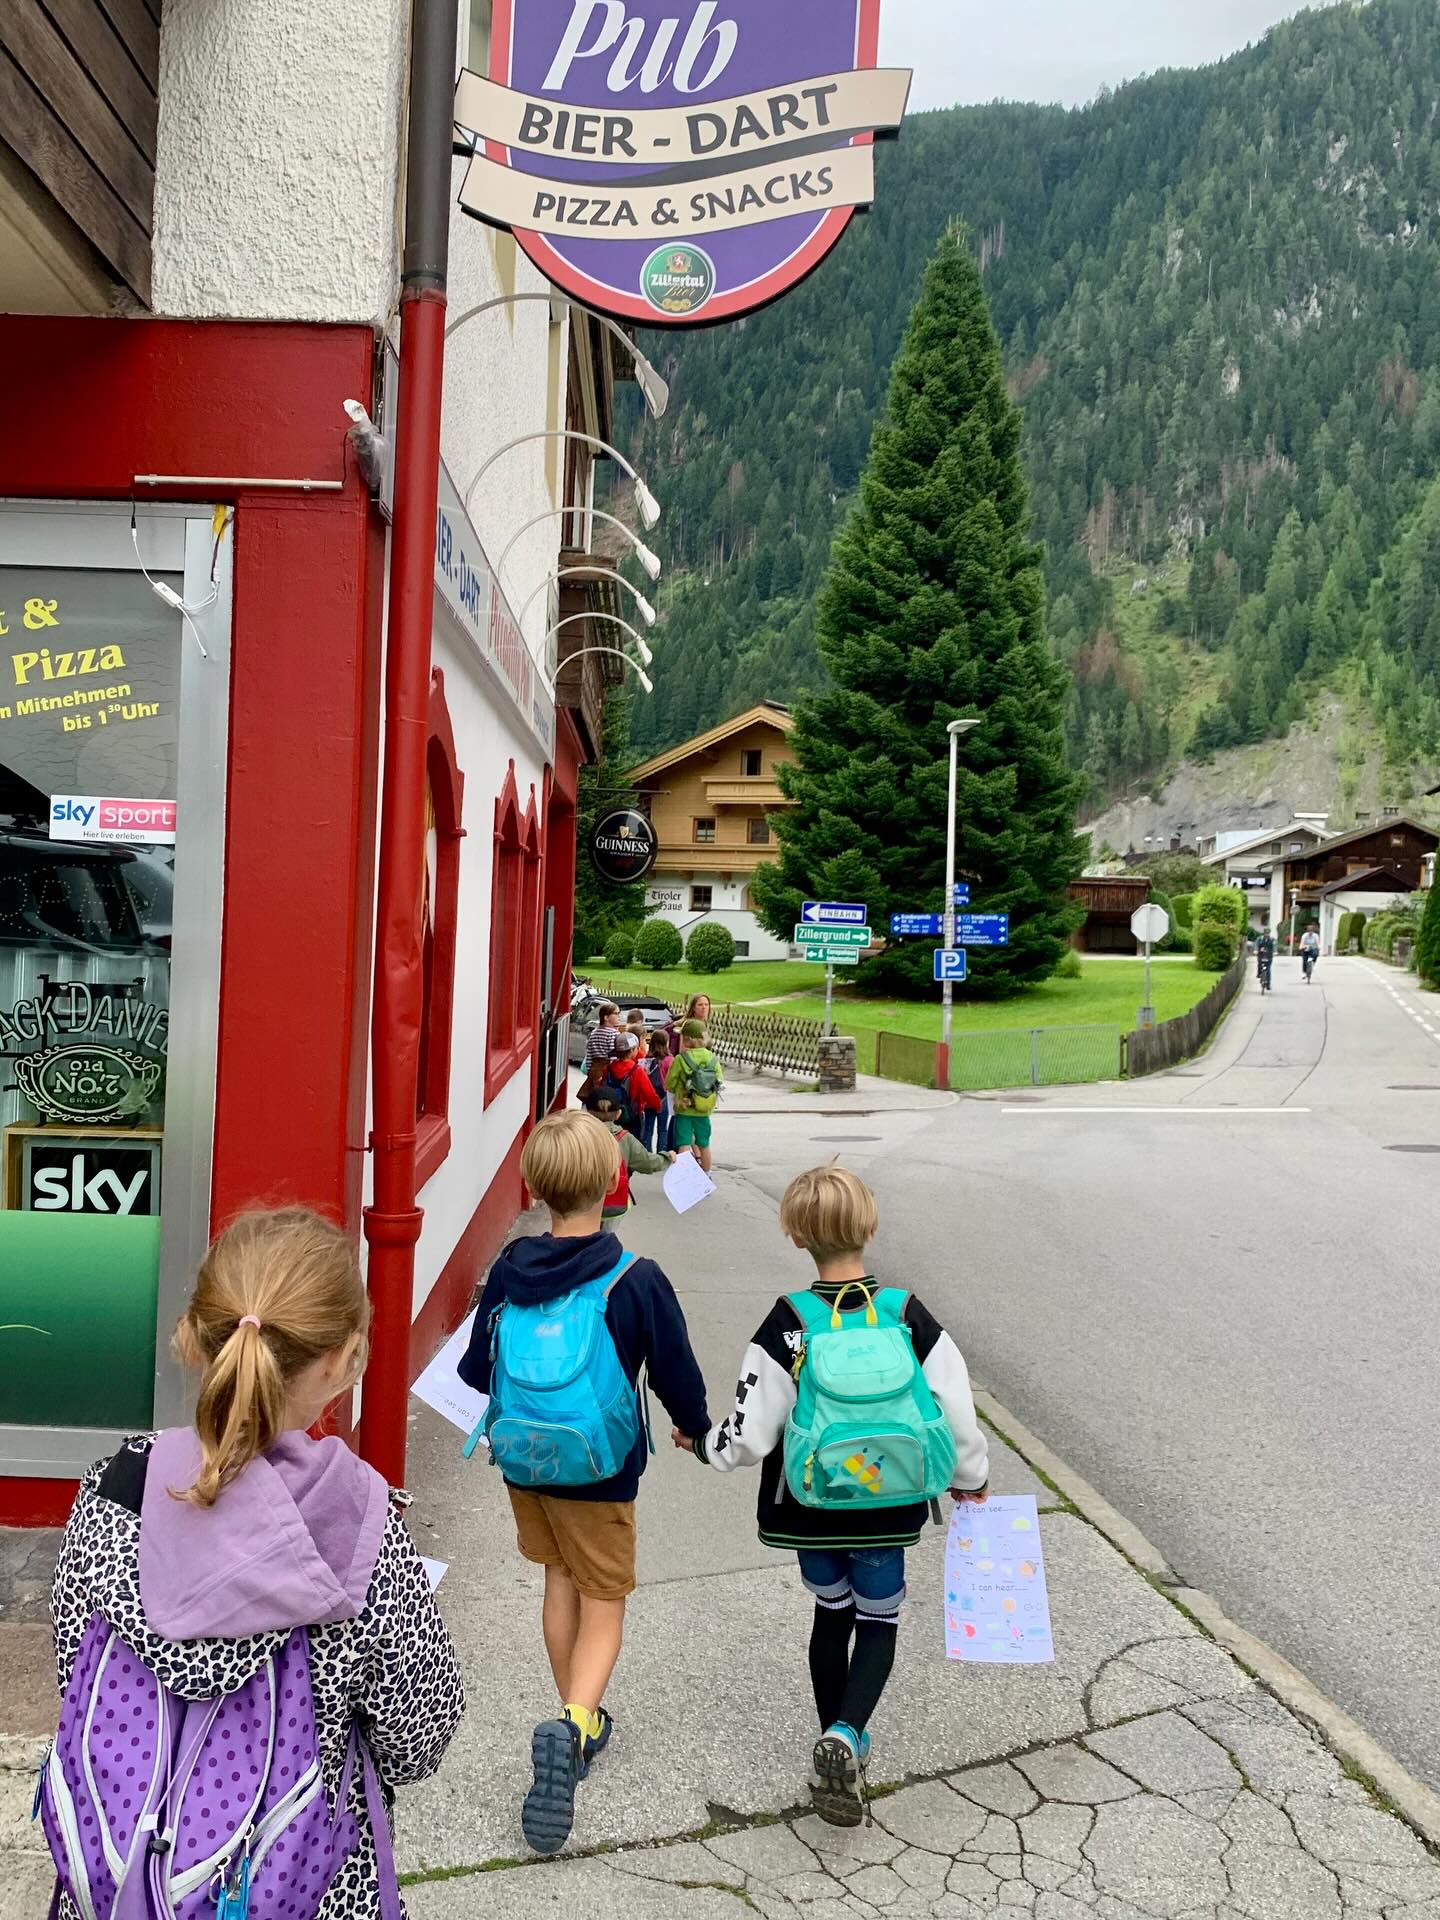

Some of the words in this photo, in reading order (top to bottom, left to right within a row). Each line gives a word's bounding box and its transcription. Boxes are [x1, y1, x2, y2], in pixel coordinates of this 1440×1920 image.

[541, 0, 738, 93] Pub
[518, 102, 637, 158] BIER
[652, 136, 672, 148] -
[686, 83, 838, 155] DART
[532, 191, 638, 226] PIZZA
[651, 198, 679, 225] &
[691, 166, 834, 221] SNACKS
[650, 273, 705, 288] Zillertal
[437, 507, 453, 583] IER
[459, 549, 481, 627] DART
[23, 598, 60, 630] &
[11, 643, 127, 685] Pizza
[16, 682, 132, 716] Mitnehmen
[63, 714, 92, 732] bis
[53, 799, 96, 826] sky
[104, 803, 173, 828] sport
[82, 830, 99, 839] Hier
[101, 830, 114, 839] live
[116, 831, 146, 841] erleben
[595, 835, 650, 854] GUINNESS
[651, 889, 682, 901] Tiroler
[658, 901, 683, 912] Haus
[818, 909, 858, 919] EINBAHN
[798, 927, 852, 943] Zillergrund
[0, 995, 59, 1051] ACK
[69, 1096, 106, 1105] BRAND
[33, 1153, 149, 1216] sky
